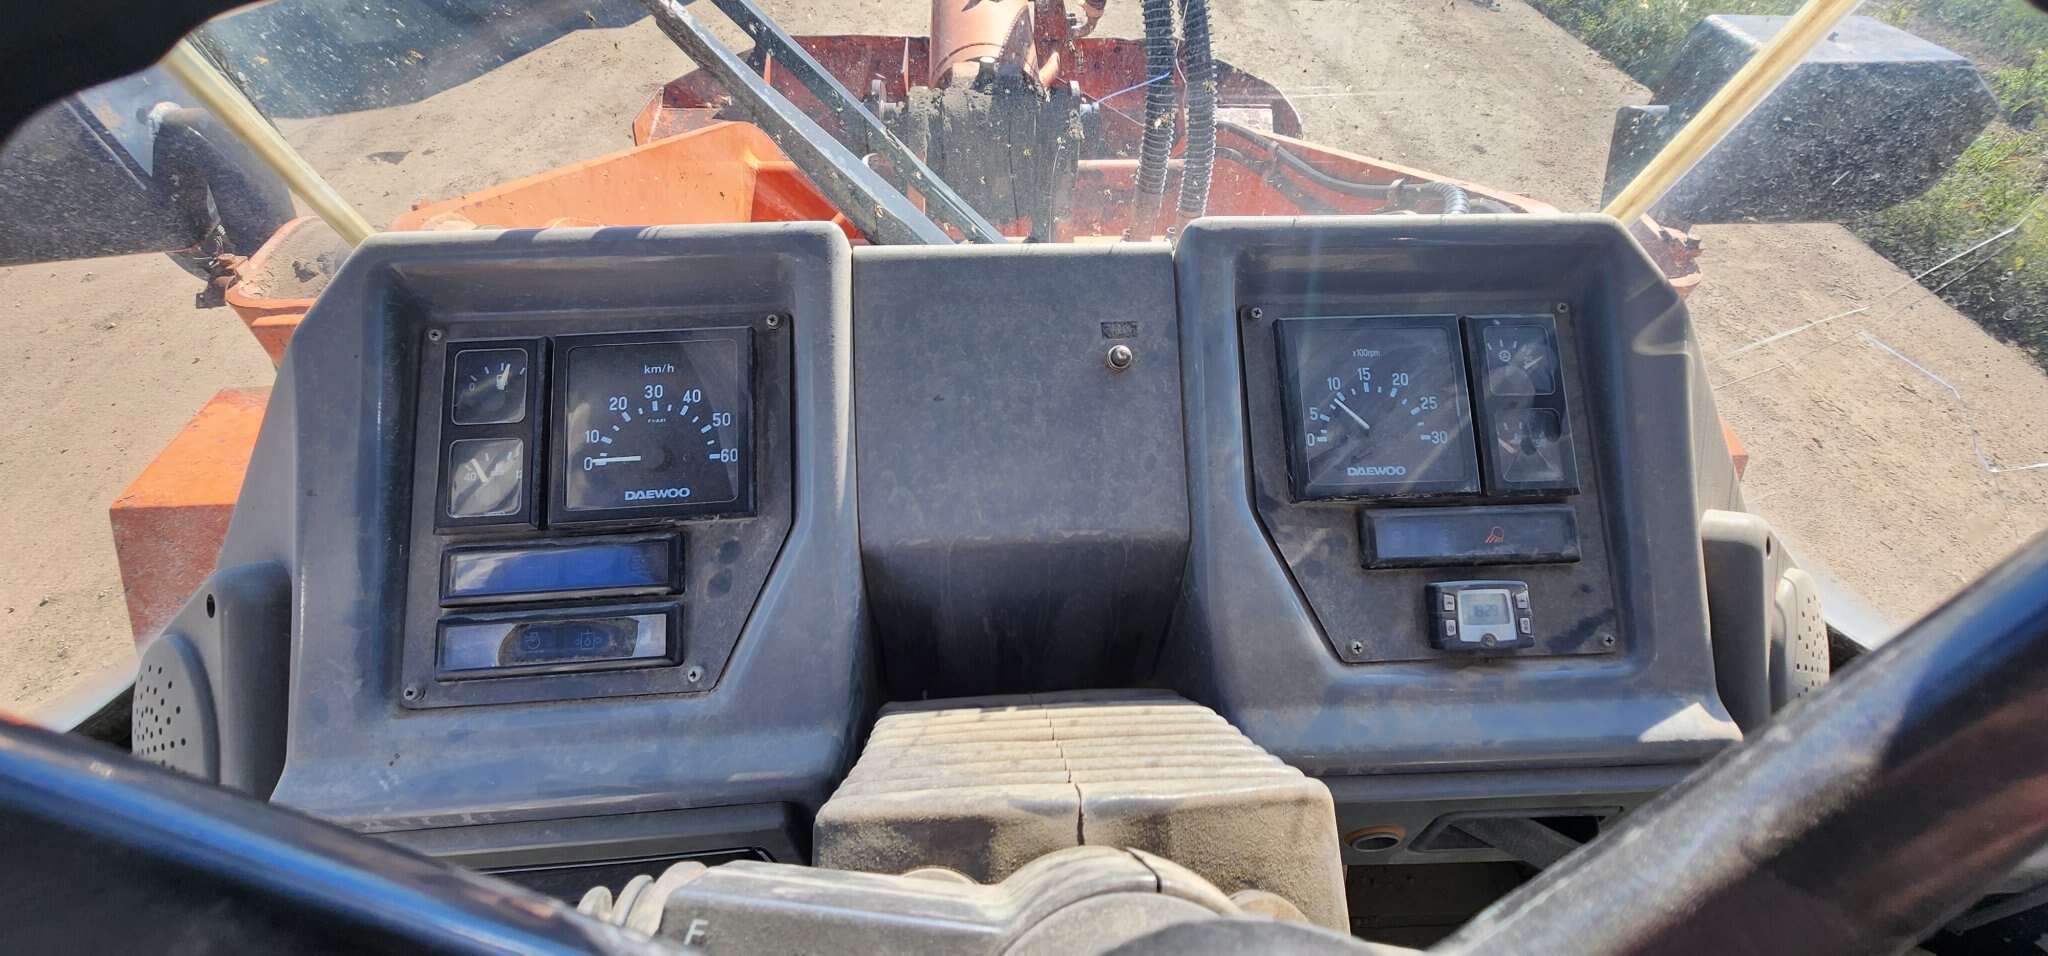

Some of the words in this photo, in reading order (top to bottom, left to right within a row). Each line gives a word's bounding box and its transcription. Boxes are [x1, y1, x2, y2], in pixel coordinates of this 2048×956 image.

[1352, 349, 1380, 358] x100rpm
[644, 363, 674, 374] km/h
[1357, 367, 1371, 381] 15
[1326, 376, 1341, 390] 10
[1392, 372, 1409, 386] 20
[469, 382, 476, 392] 0
[644, 384, 663, 399] 30
[682, 388, 701, 403] 40
[609, 396, 628, 411] 20
[1420, 396, 1438, 410] 25
[712, 412, 731, 427] 50
[1309, 407, 1318, 421] 5
[585, 429, 600, 443] 10
[1306, 433, 1316, 447] 0
[1431, 431, 1448, 444] 30
[720, 448, 738, 463] 60
[583, 457, 593, 471] 0
[1347, 465, 1406, 476] DAEWOO
[463, 471, 477, 481] 40
[624, 487, 691, 501] DAEWOO
[684, 919, 709, 945] F
